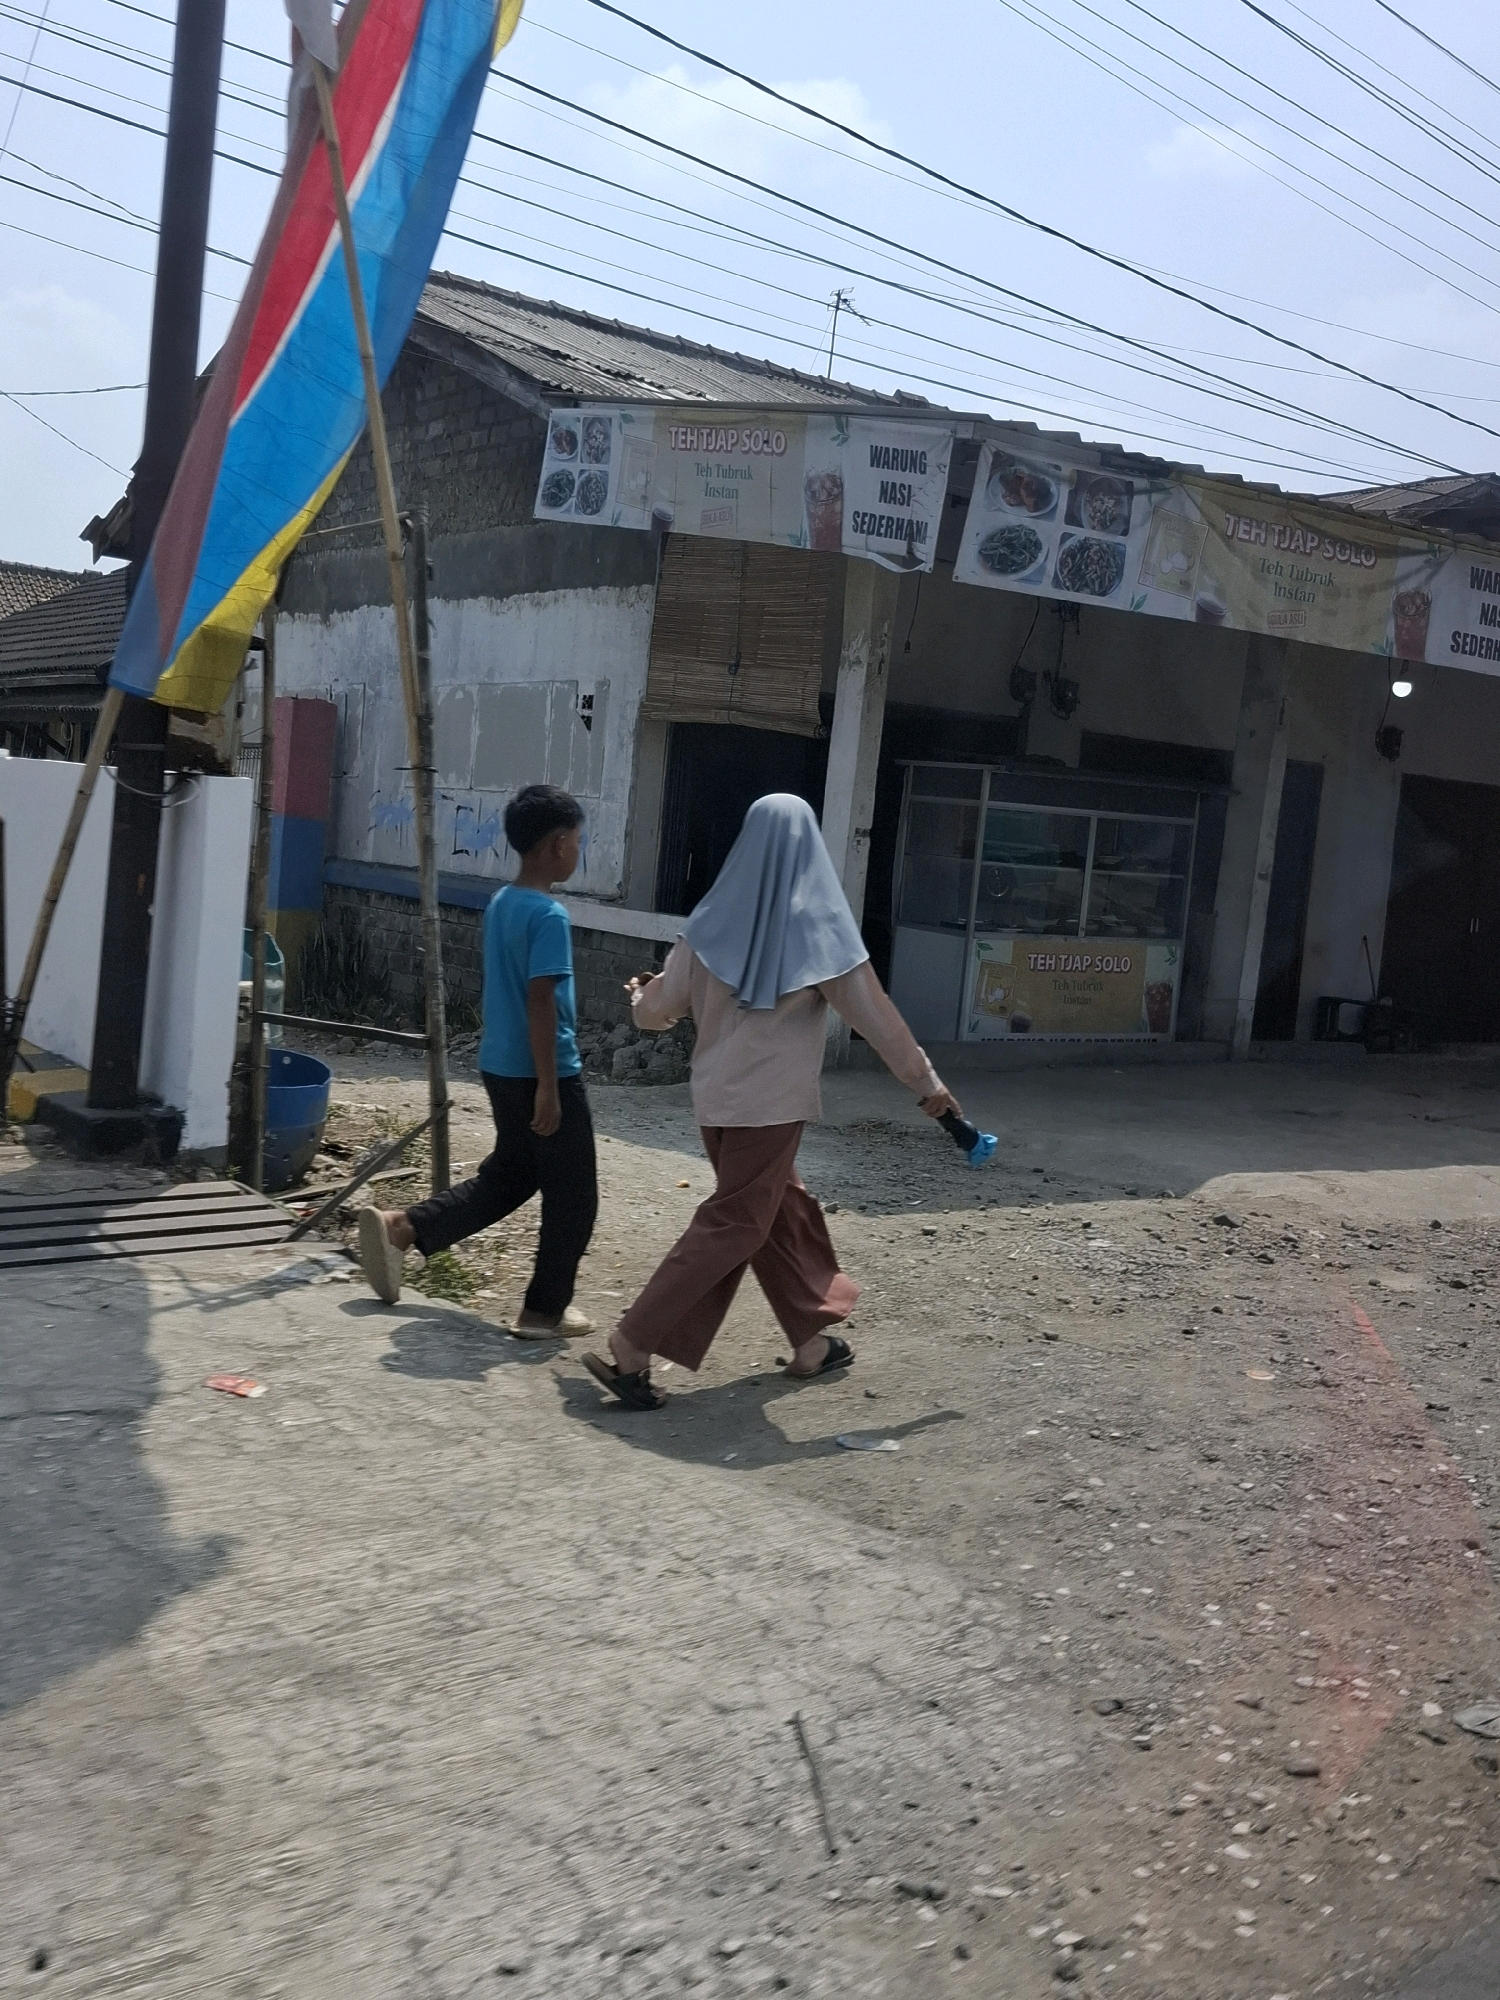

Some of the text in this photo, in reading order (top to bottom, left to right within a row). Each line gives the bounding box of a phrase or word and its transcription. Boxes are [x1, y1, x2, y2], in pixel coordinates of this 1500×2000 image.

[669, 426, 787, 456] TEH TJAP SOLO
[694, 462, 754, 480] Teh Tubruk
[869, 444, 928, 475] WARUNG
[704, 483, 738, 499] Instan
[878, 480, 912, 507] NASI
[852, 511, 928, 545] SEDERHANA
[1225, 513, 1268, 547] TEH
[1270, 523, 1320, 556] TJAP
[1322, 538, 1377, 568] SOLO
[1259, 557, 1337, 587] Teh Tubruk
[1273, 582, 1316, 603] Instan
[1028, 953, 1132, 974] TEH TJAP SOLO
[1052, 980, 1069, 991] Teh
